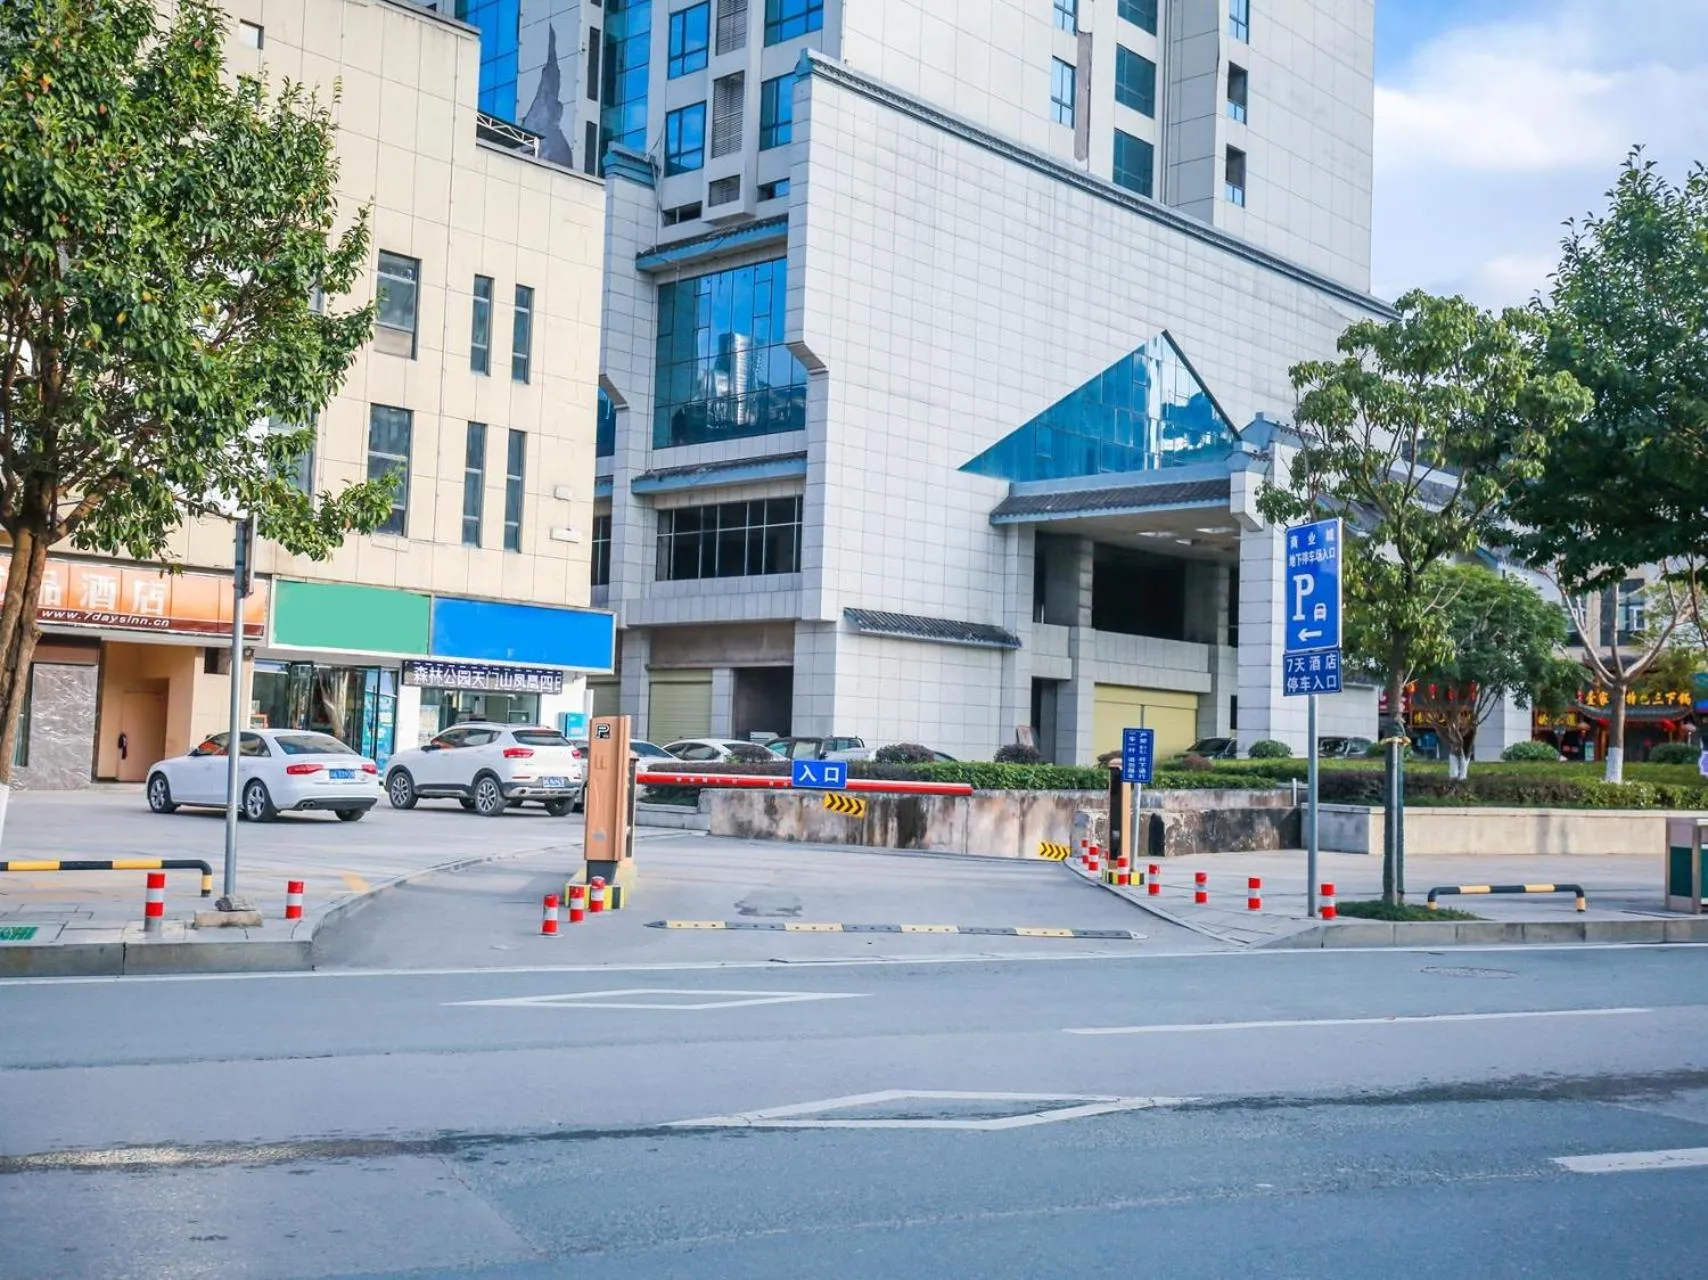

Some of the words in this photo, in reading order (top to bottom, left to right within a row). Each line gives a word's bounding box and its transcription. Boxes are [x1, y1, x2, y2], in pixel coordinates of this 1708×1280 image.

[0, 565, 166, 616] 品酒店
[1293, 573, 1315, 621] P
[41, 608, 170, 627] www.7daysinn.cn
[1286, 653, 1337, 673] 7天酒店
[1287, 675, 1337, 693] 停车入口
[799, 764, 839, 783] 入口
